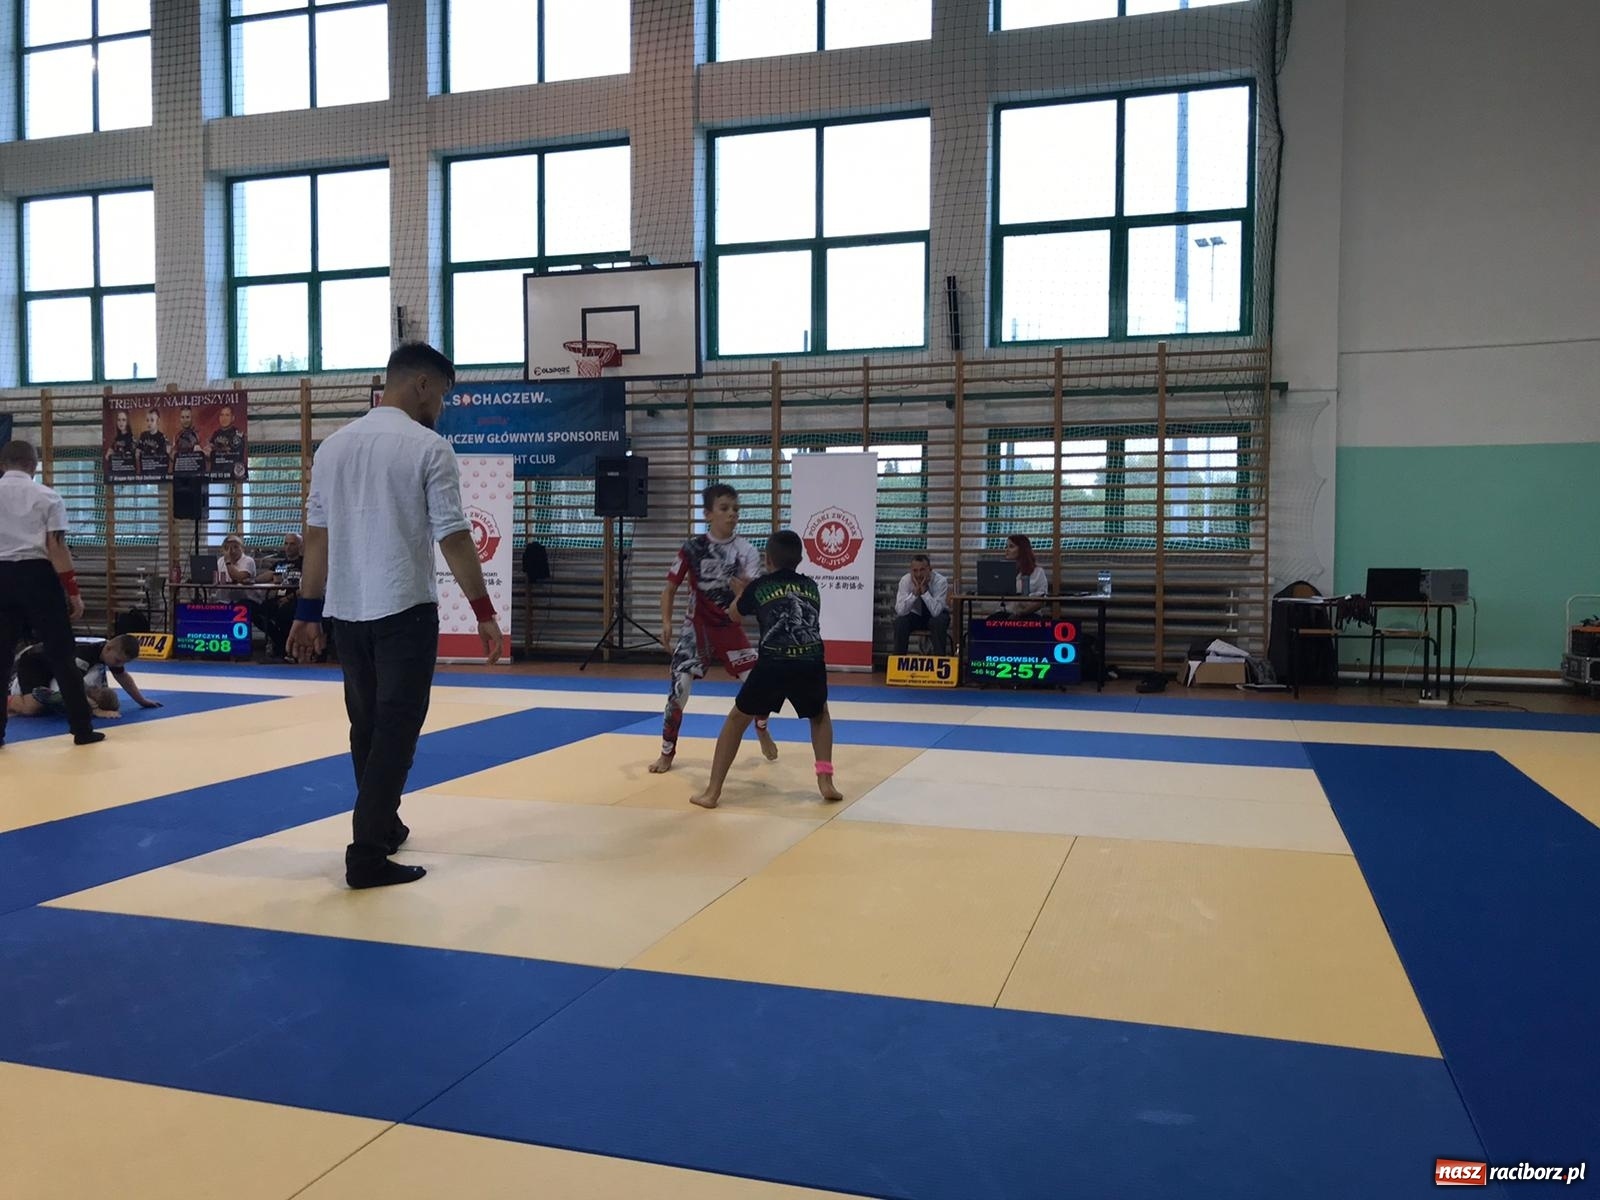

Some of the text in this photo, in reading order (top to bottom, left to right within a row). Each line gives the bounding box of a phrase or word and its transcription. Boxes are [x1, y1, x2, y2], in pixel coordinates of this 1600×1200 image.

[109, 393, 239, 409] TRENUJ Z NAJLEPSZYMI
[487, 431, 545, 443] GŁÓWNYM
[547, 431, 619, 442] SPONSOREM
[529, 454, 556, 464] CLUB
[233, 605, 248, 622] 2
[233, 622, 248, 640] 0
[1054, 621, 1076, 642] 0
[154, 635, 168, 653] 4
[195, 639, 231, 652] 2:08
[986, 655, 1049, 664] ROGOWSKI A
[1054, 643, 1076, 663] 0
[897, 657, 951, 680] MATA 5
[996, 663, 1051, 679] 2:57
